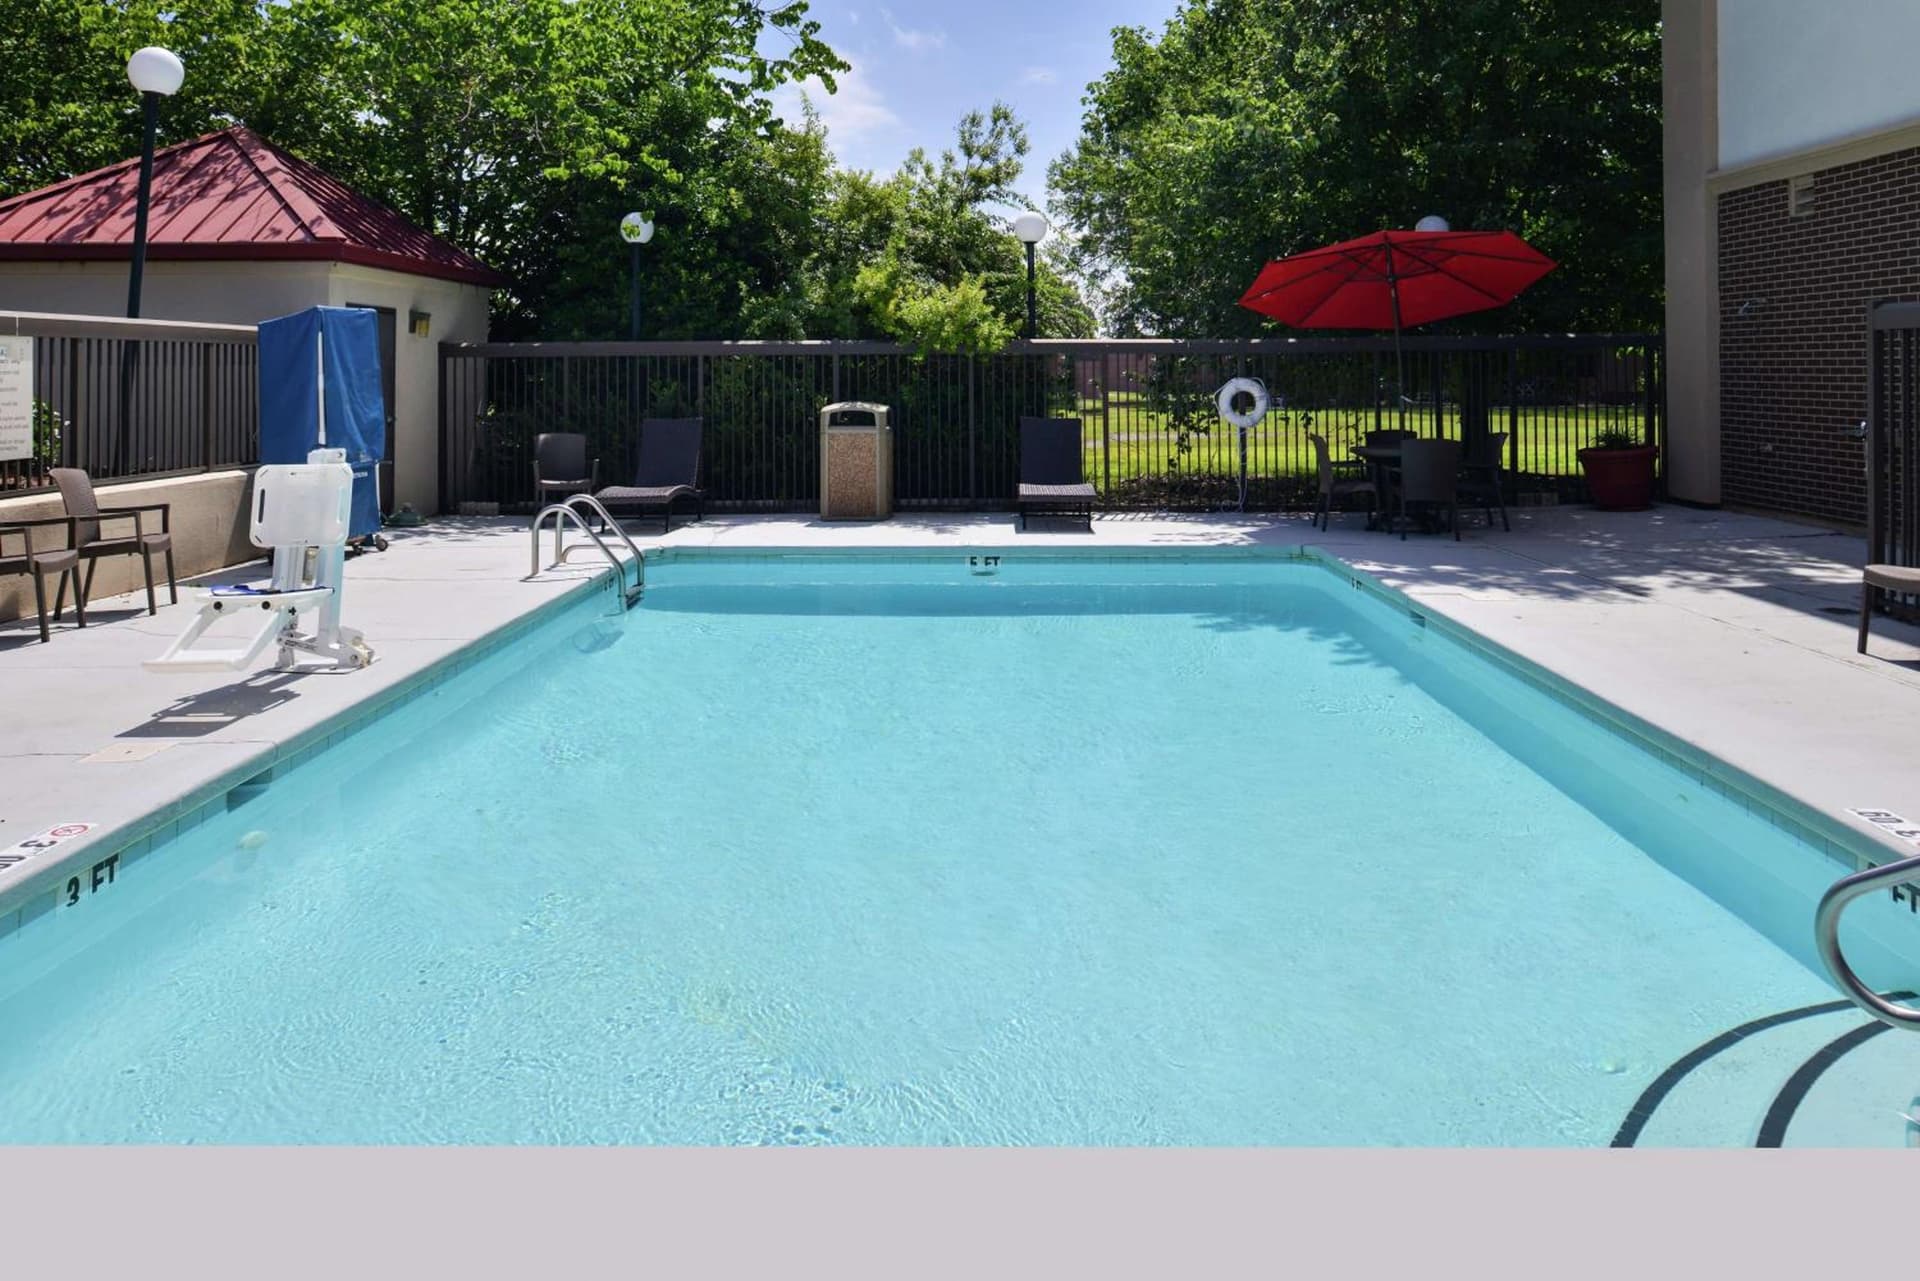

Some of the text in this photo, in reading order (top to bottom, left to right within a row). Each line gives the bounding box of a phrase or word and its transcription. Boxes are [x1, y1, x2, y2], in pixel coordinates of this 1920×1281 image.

[984, 556, 1001, 567] FT
[66, 853, 120, 907] 3 FT
